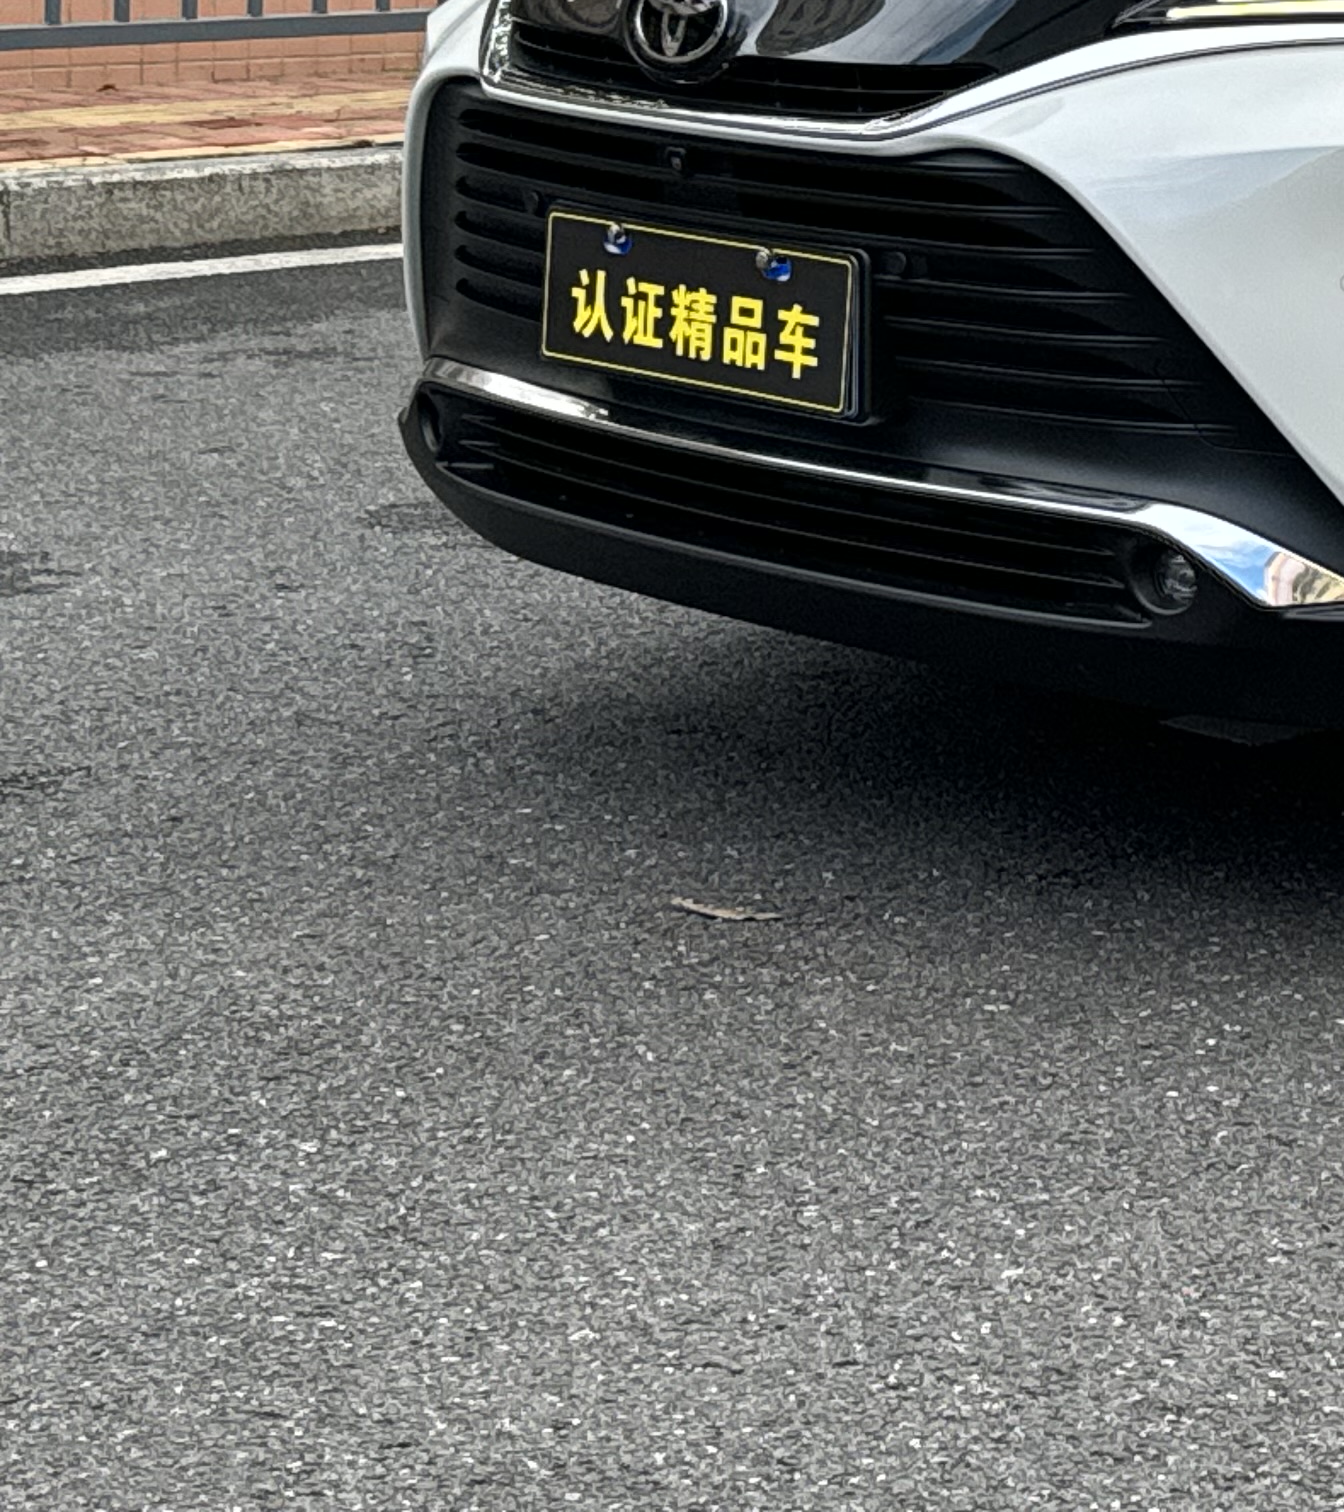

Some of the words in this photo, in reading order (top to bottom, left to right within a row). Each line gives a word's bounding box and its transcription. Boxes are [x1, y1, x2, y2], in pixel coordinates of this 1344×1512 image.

[571, 268, 820, 380] 认证精品车
